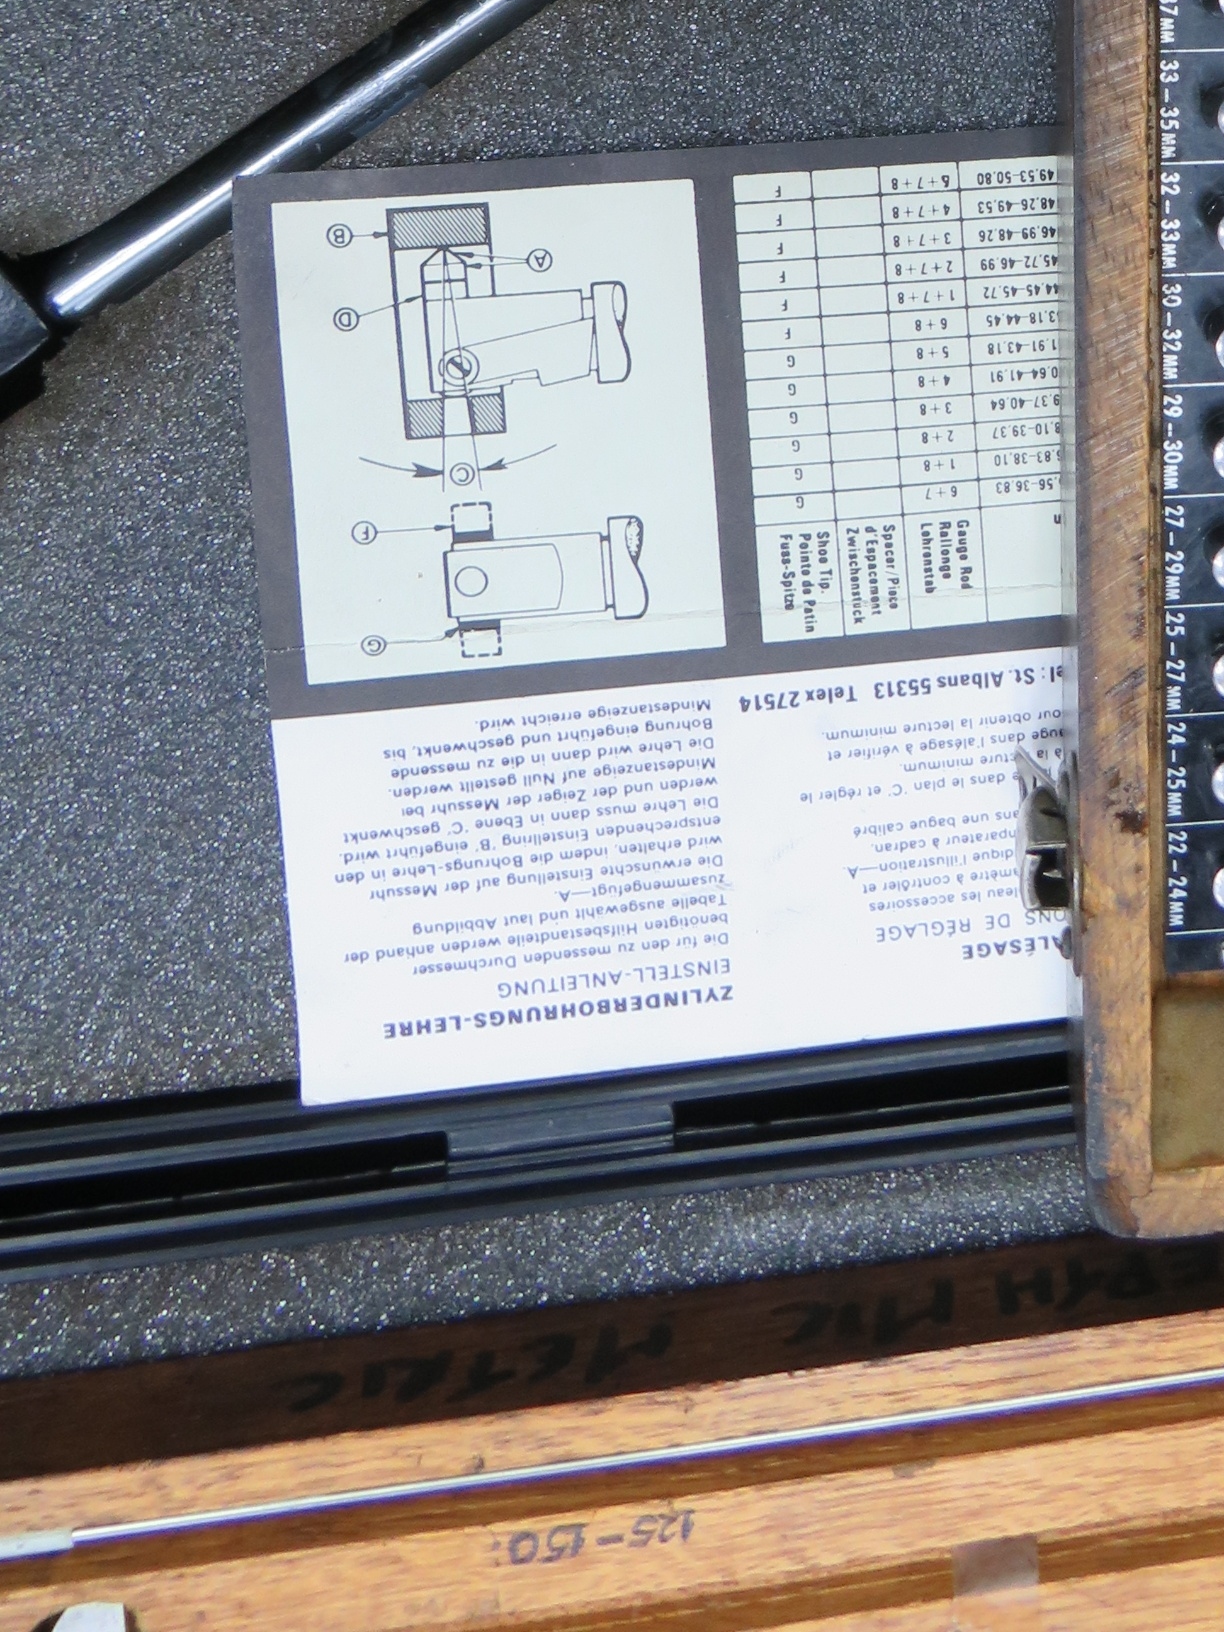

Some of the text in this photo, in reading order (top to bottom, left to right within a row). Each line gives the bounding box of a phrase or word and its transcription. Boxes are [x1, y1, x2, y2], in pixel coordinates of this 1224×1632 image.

[920, 522, 937, 594] Lehrenstab
[938, 521, 953, 579] Rallonge
[780, 534, 796, 610] Fuss-Spitze
[816, 531, 833, 594] Shoe Tip.
[799, 533, 816, 633] Pointe de Patin
[959, 567, 973, 589] Rod
[738, 667, 1035, 713] St. Albans 55313 Telex 27514
[474, 716, 517, 733] wird.
[520, 710, 583, 728] erreicht
[644, 716, 714, 733] Bohrung
[821, 711, 1031, 743] obtenir lecture minimum.
[556, 723, 640, 743] eingeführt
[990, 731, 1025, 746] dans
[382, 747, 407, 761] bis
[390, 736, 715, 781] Die Lehre wird dann messende
[848, 744, 899, 760] vérifier
[899, 757, 973, 774] minimum.
[458, 772, 518, 794] gestellt
[522, 771, 556, 788] Null
[561, 768, 588, 785] auf
[659, 775, 719, 793] werden
[387, 782, 454, 800] werden.
[536, 787, 588, 804] Zeiger
[818, 771, 1007, 803] dans plan régler
[430, 797, 501, 816] Messuhr
[342, 795, 720, 845] Die Lehre muss dann Ebene geschwenkt
[852, 812, 990, 839] une bague calibré
[501, 827, 590, 848] Einstellring
[686, 834, 724, 851] wird
[870, 838, 927, 854] cadran.
[338, 849, 381, 867] wird.
[385, 839, 470, 860] eingeführt
[558, 846, 609, 862] indem
[369, 853, 724, 903] Die erwünschte Einstellung auf Messuhr
[882, 874, 951, 893] contrôler
[868, 890, 982, 913] les accessoires
[411, 893, 728, 936] Tabelle ausgewählt laut Abbildung
[643, 912, 729, 931] benötigten
[984, 912, 1011, 931] DE
[874, 917, 972, 944] RÉGLAGE
[374, 943, 436, 963] anhand
[412, 931, 730, 976] Die für messenden Durchmesser
[440, 936, 502, 954] werden
